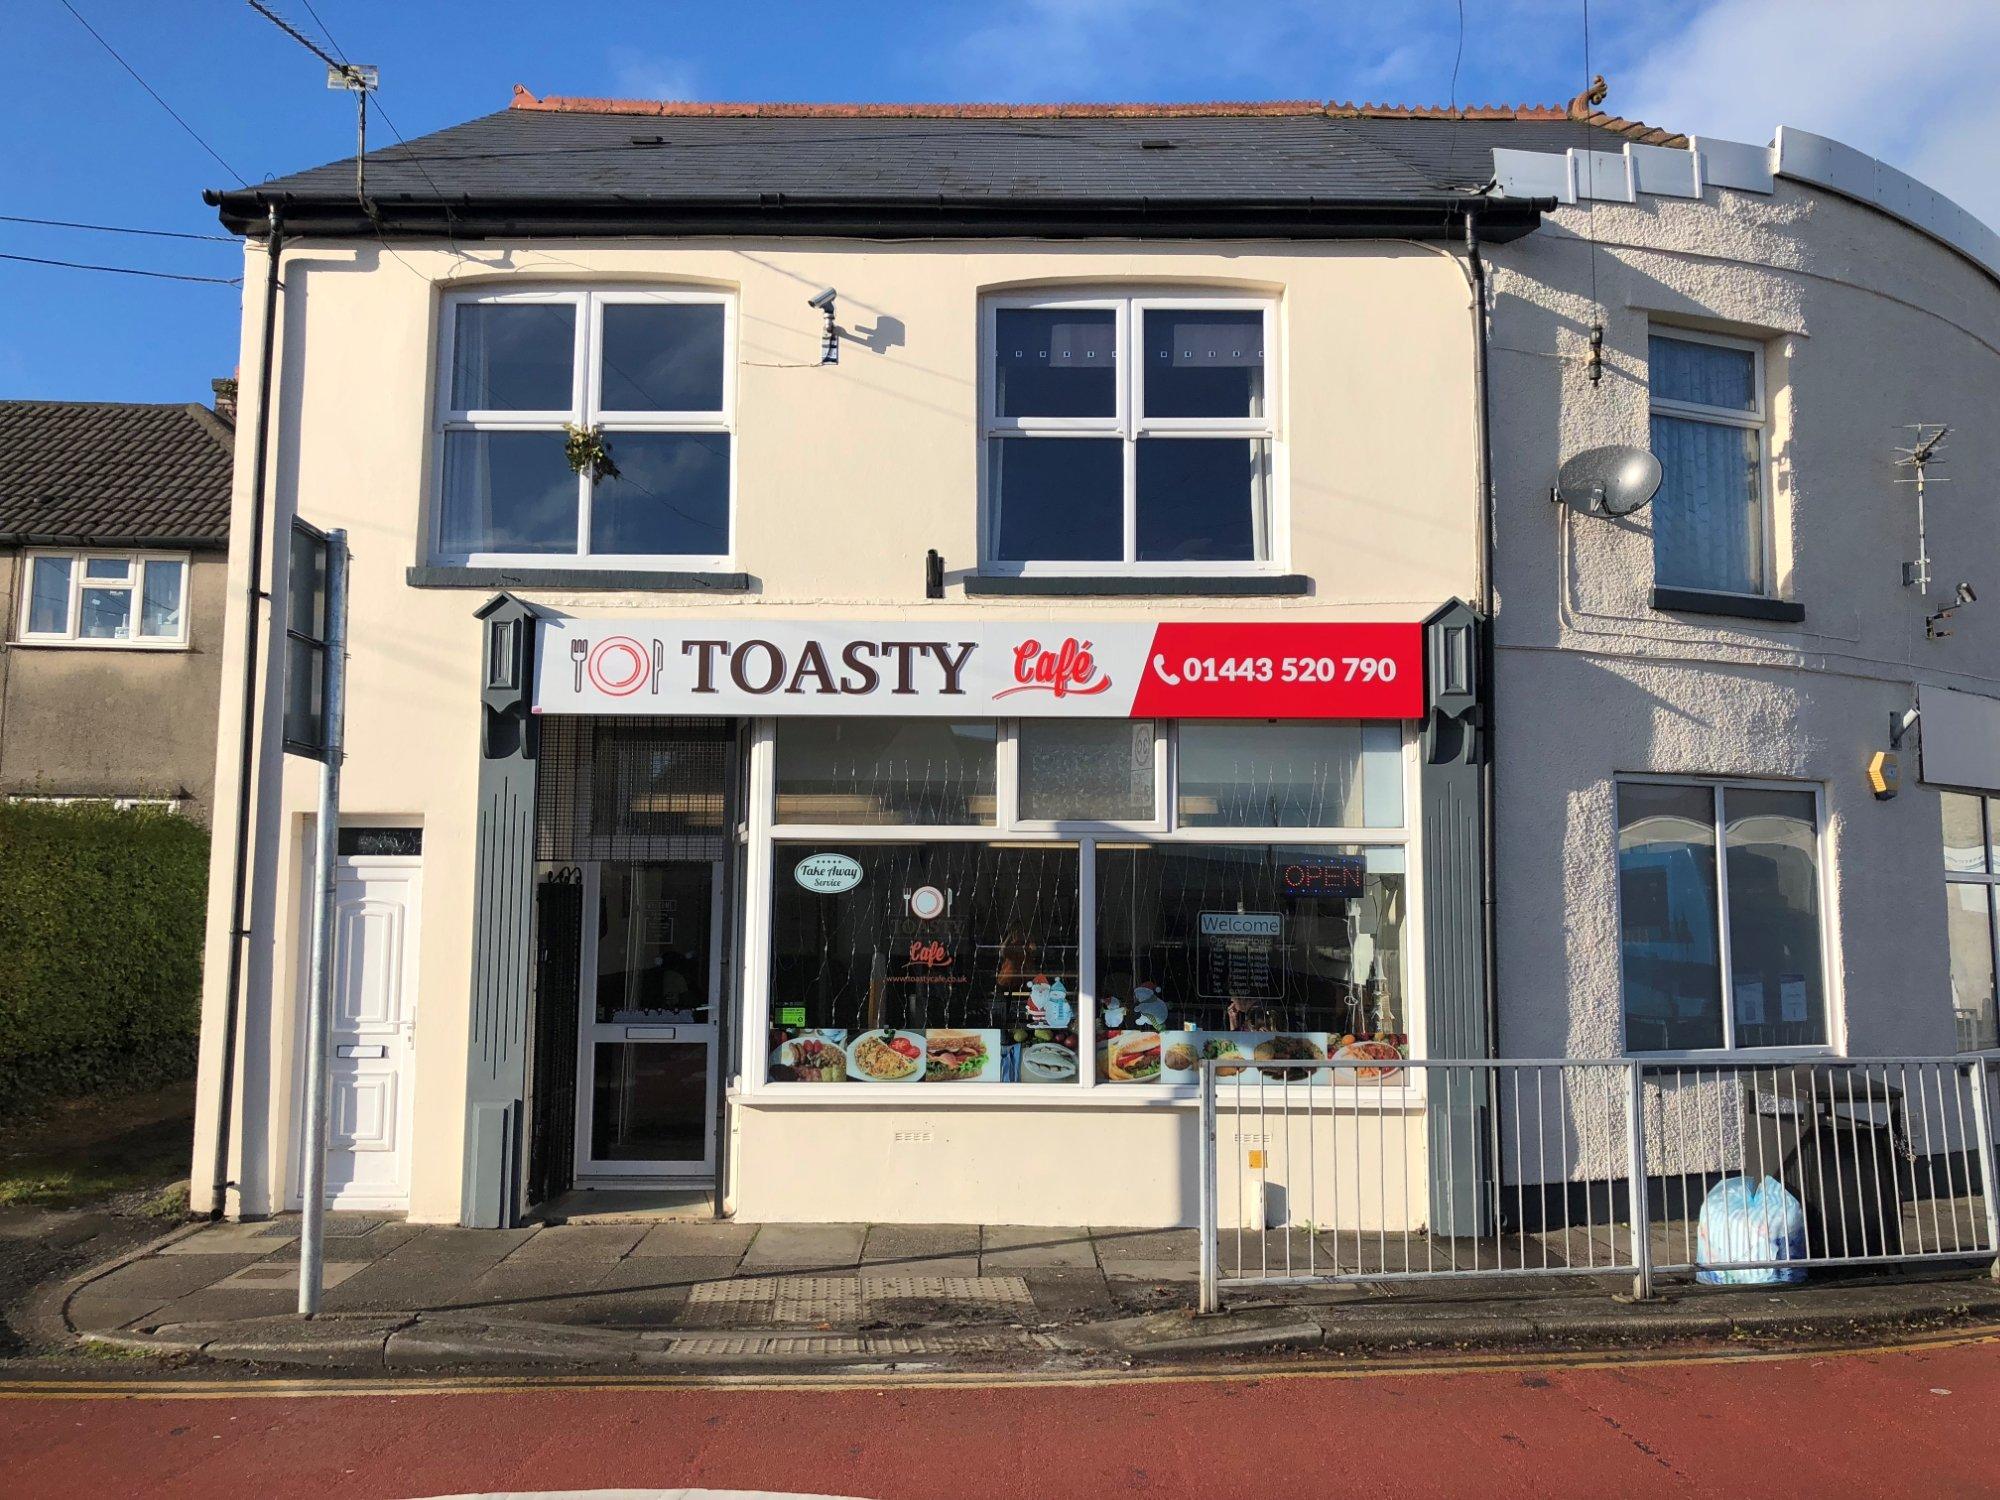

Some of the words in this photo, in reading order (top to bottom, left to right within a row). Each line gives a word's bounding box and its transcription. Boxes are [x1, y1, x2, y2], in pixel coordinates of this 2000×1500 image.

[682, 639, 978, 695] TOASTY
[1012, 637, 1099, 698] Café
[1183, 656, 1273, 683] 01443
[1281, 656, 1335, 683] 520
[1342, 656, 1397, 683] 790
[801, 865, 826, 876] Take
[827, 865, 858, 879] Away
[813, 878, 842, 887] Service
[1285, 865, 1360, 887] OPEN
[1203, 917, 1279, 932] Welcome
[910, 941, 945, 967] Café
